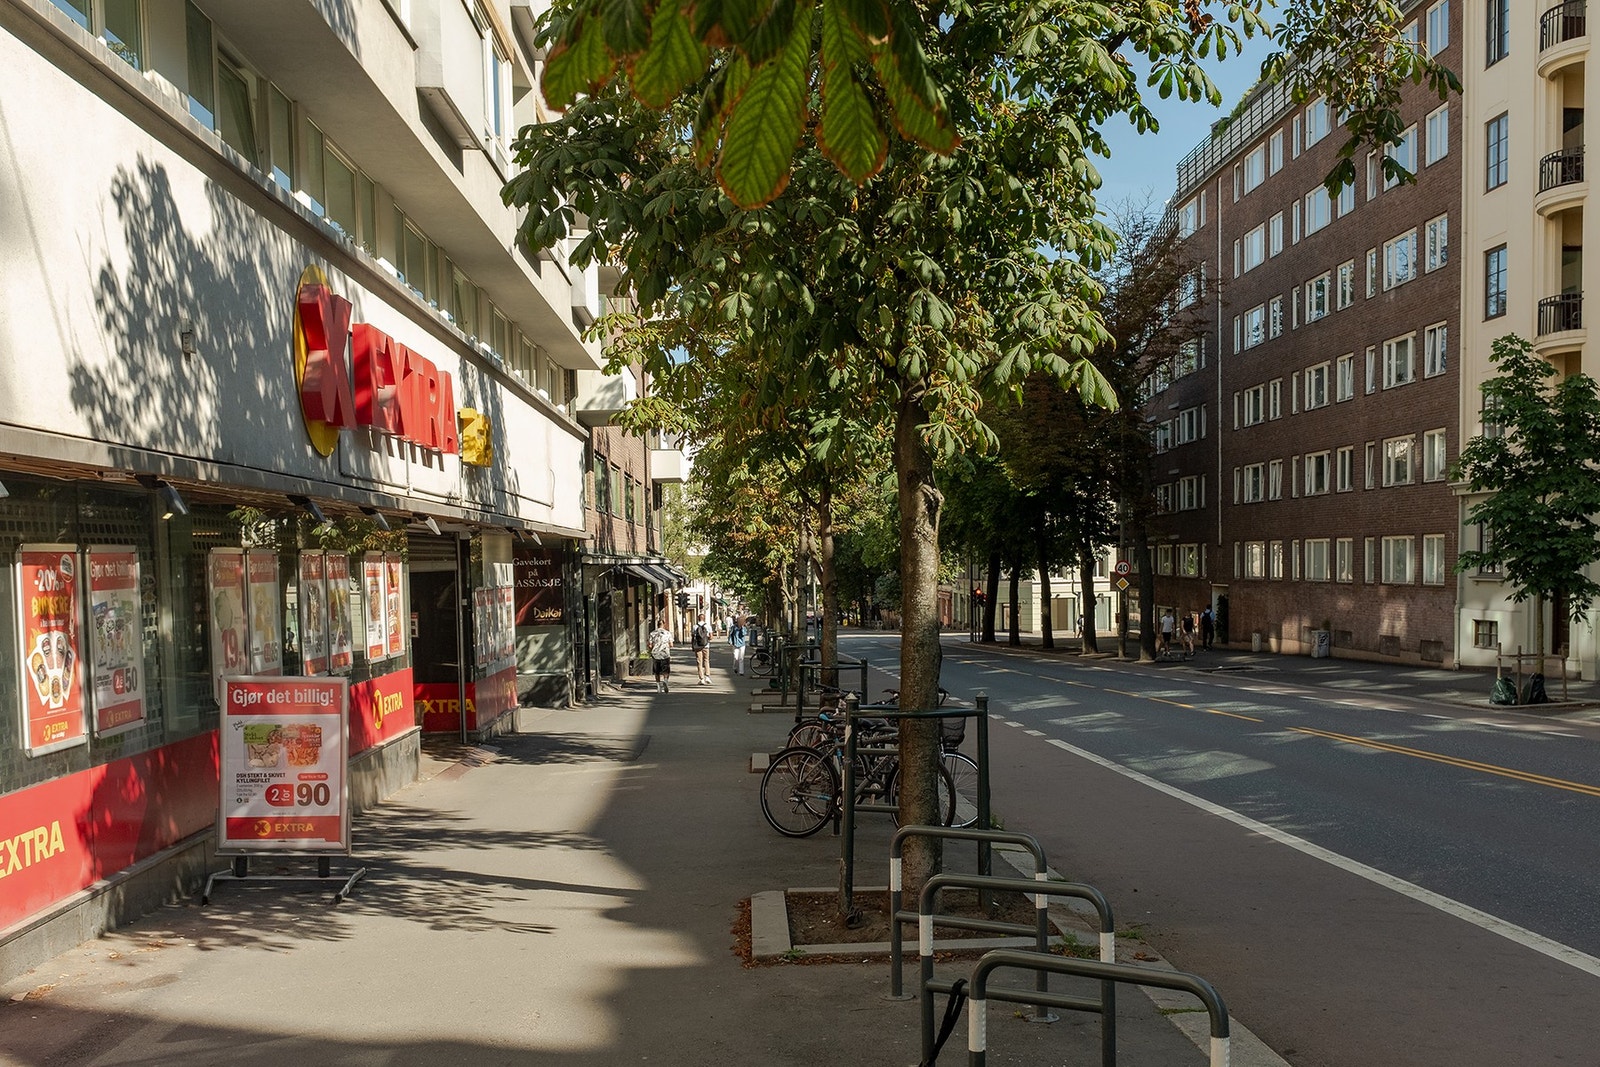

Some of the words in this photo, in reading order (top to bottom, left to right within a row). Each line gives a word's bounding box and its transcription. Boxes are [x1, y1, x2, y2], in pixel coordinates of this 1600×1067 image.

[352, 323, 459, 454] EXTRA
[512, 557, 551, 566] Gavekort
[1117, 564, 1128, 572] 40
[528, 569, 538, 578] på
[514, 578, 562, 588] ASSASJE
[125, 666, 138, 693] 50
[233, 689, 263, 707] Gjør
[266, 689, 291, 703] det
[294, 689, 334, 706] billig!
[383, 691, 403, 716] EXTRA
[271, 788, 280, 802] 2
[297, 783, 330, 806] 90
[274, 823, 314, 832] EXTRA
